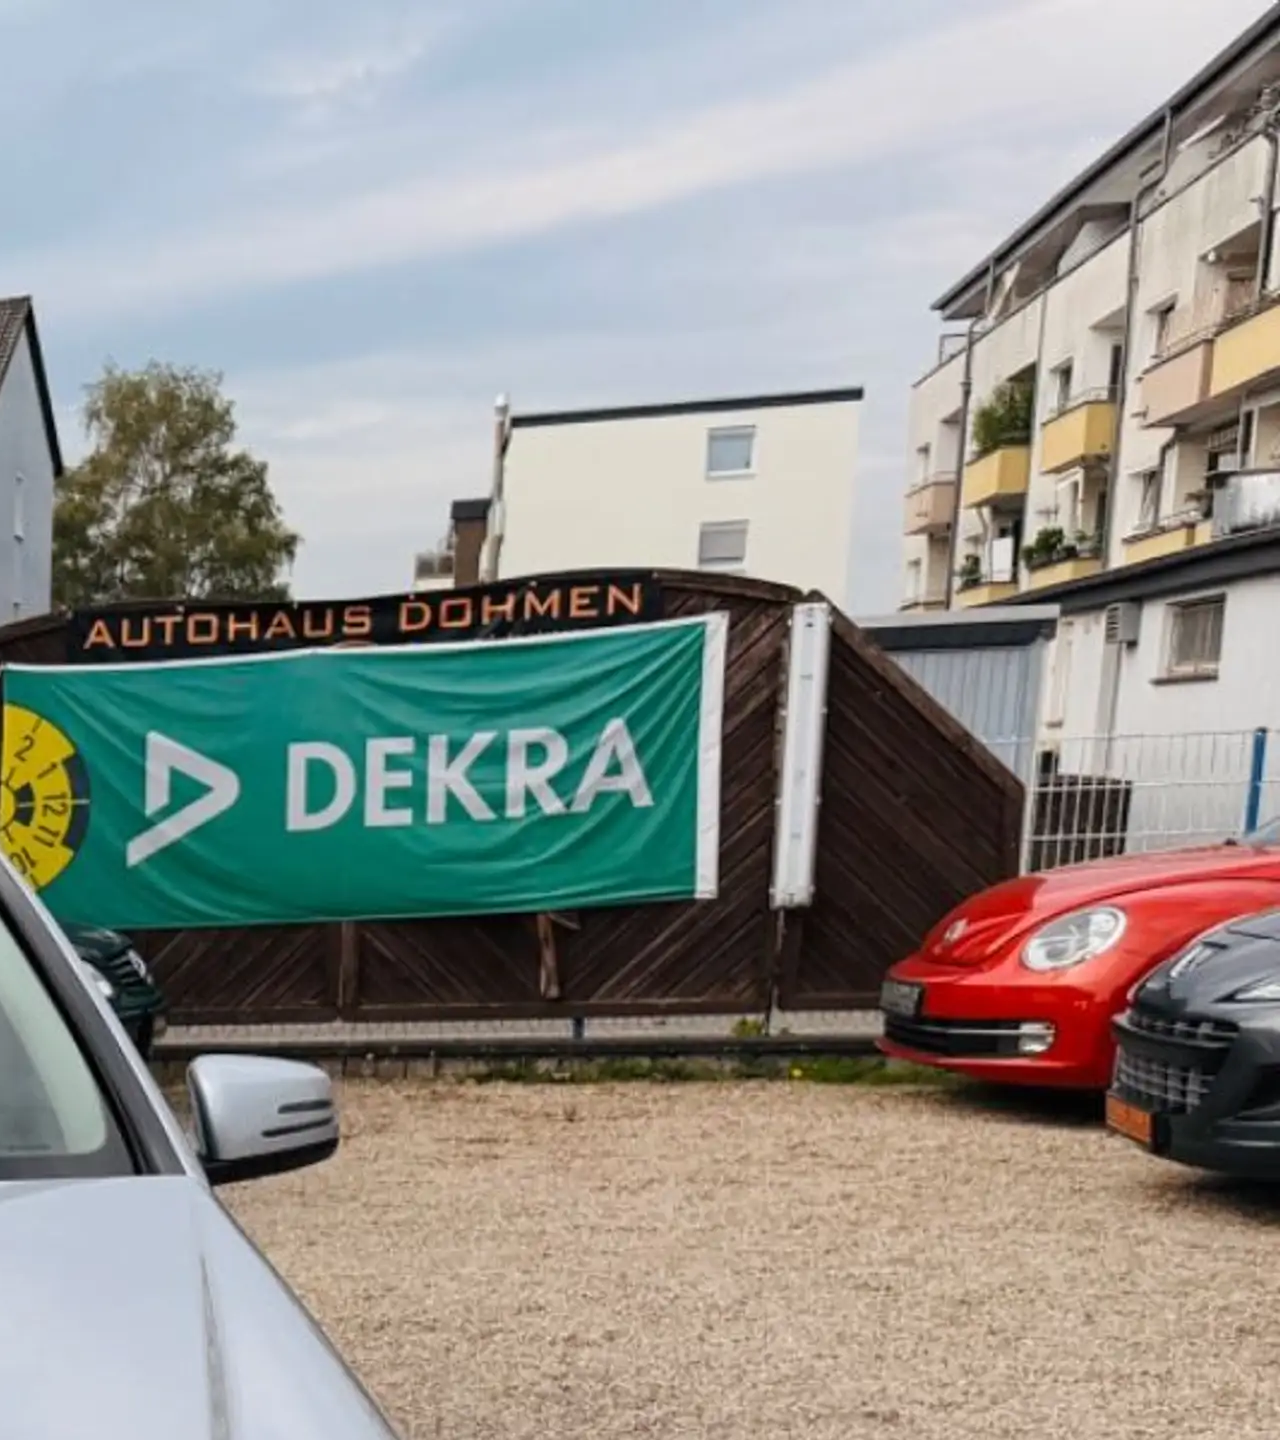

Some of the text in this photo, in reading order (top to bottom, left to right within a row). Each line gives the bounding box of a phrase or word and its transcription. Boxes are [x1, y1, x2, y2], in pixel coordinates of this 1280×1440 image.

[83, 583, 643, 650] AUTOHAUS DOHMEN
[13, 734, 35, 762] 2
[37, 762, 58, 780] 1
[286, 717, 654, 833] DEKRA
[41, 793, 69, 817] 12
[32, 826, 61, 849] 11
